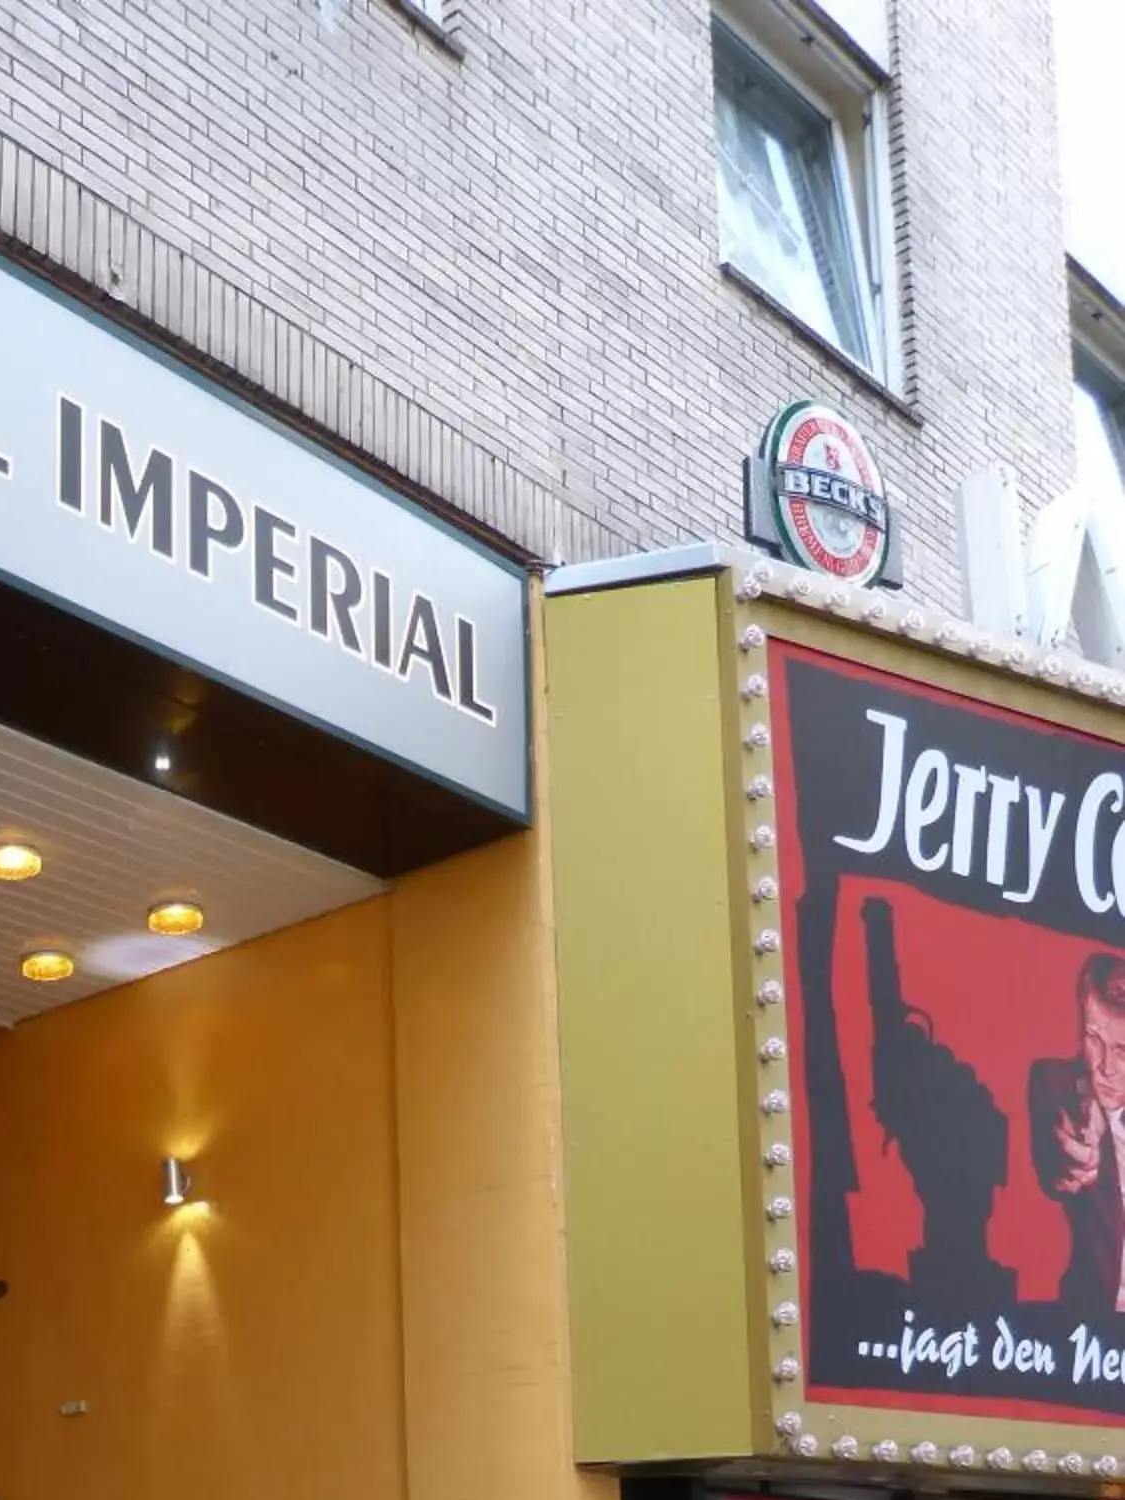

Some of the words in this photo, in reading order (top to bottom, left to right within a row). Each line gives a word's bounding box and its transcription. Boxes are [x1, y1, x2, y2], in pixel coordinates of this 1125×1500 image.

[56, 390, 496, 728] IMPERIAL
[832, 708, 1066, 904] Jerry
[1074, 772, 1125, 919] C
[992, 1316, 1057, 1376] den
